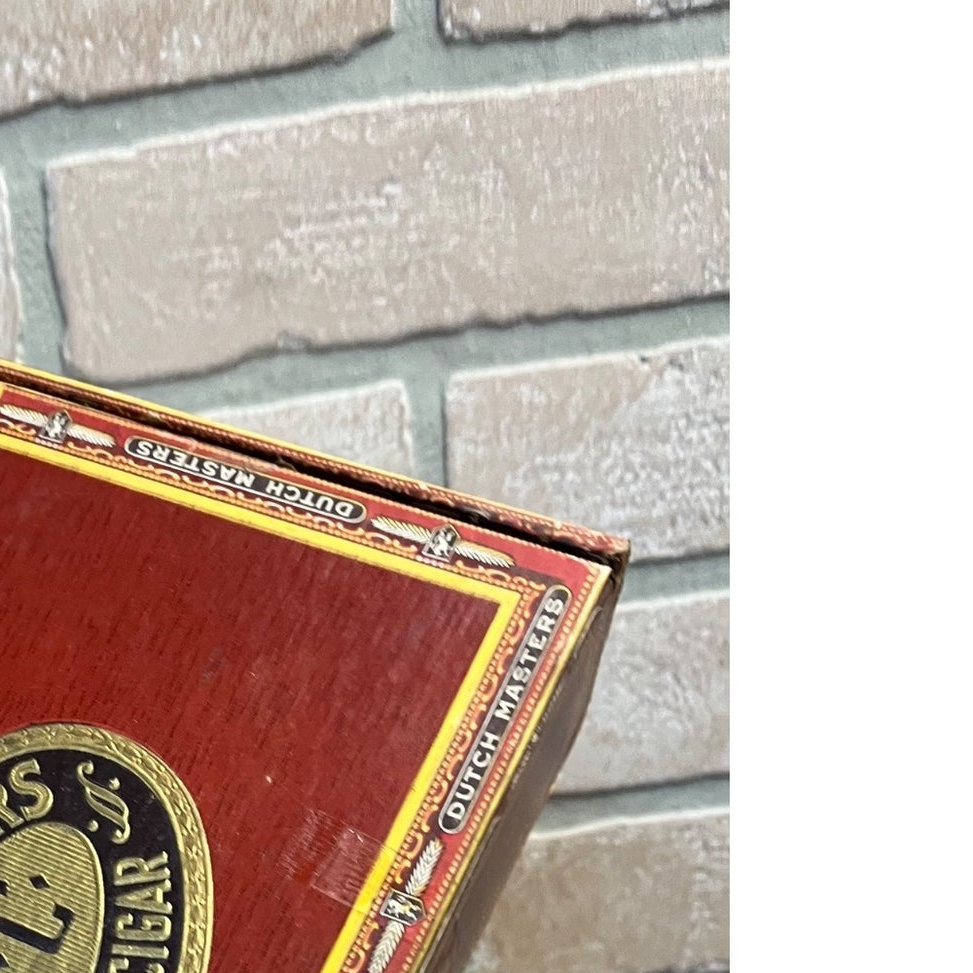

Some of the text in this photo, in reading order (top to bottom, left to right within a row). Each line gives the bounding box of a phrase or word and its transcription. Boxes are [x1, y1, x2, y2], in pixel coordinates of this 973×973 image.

[136, 440, 354, 518] DUTCH MASTERS
[447, 598, 564, 821] DUTCH MASTERS
